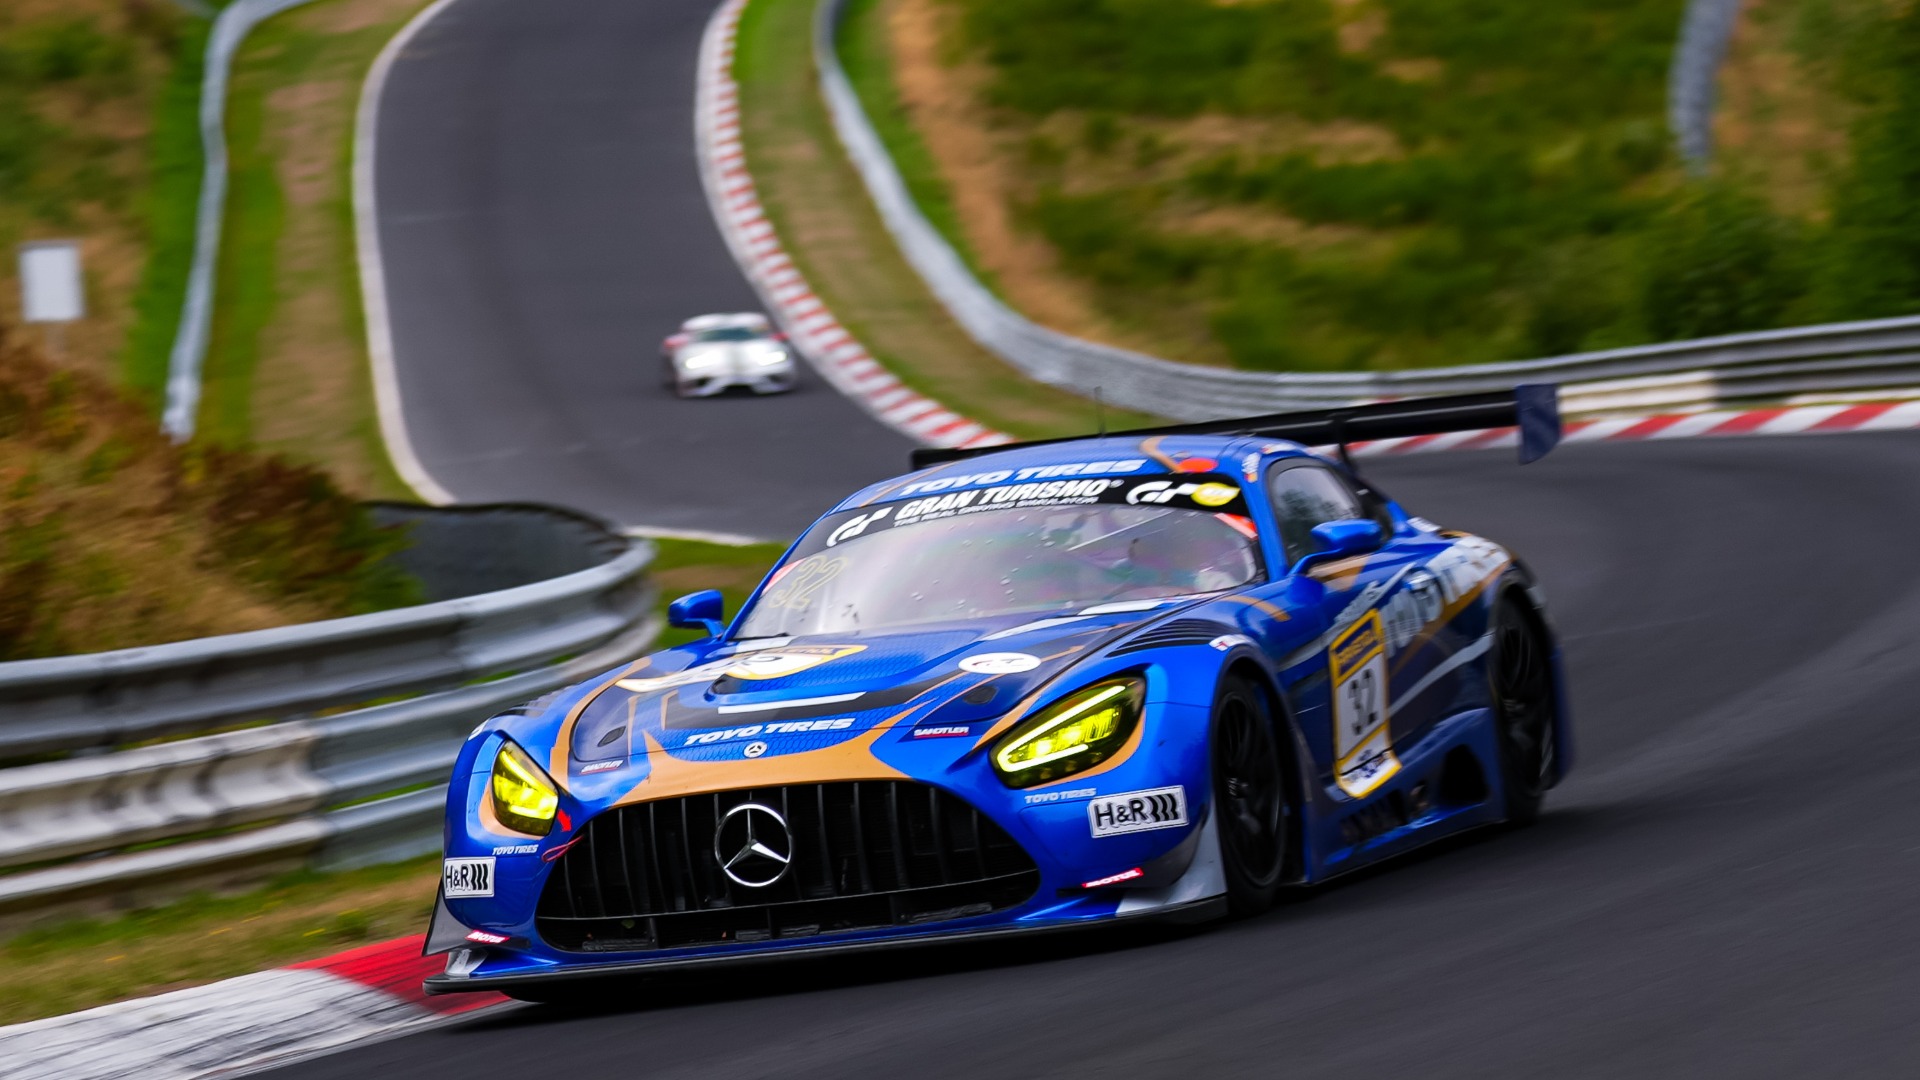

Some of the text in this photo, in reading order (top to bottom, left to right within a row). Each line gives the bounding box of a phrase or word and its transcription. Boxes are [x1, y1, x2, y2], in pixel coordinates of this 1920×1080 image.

[899, 459, 1149, 496] TOYO TIRES
[895, 490, 980, 520] GRAN
[767, 554, 848, 608] 32
[1348, 667, 1378, 735] 32
[684, 718, 856, 746] TOYO TIRES
[1025, 788, 1096, 804] TOYO TIRES
[1094, 798, 1148, 827] H&R
[492, 844, 539, 856] TOYO TIRES
[445, 865, 469, 889] H&R
